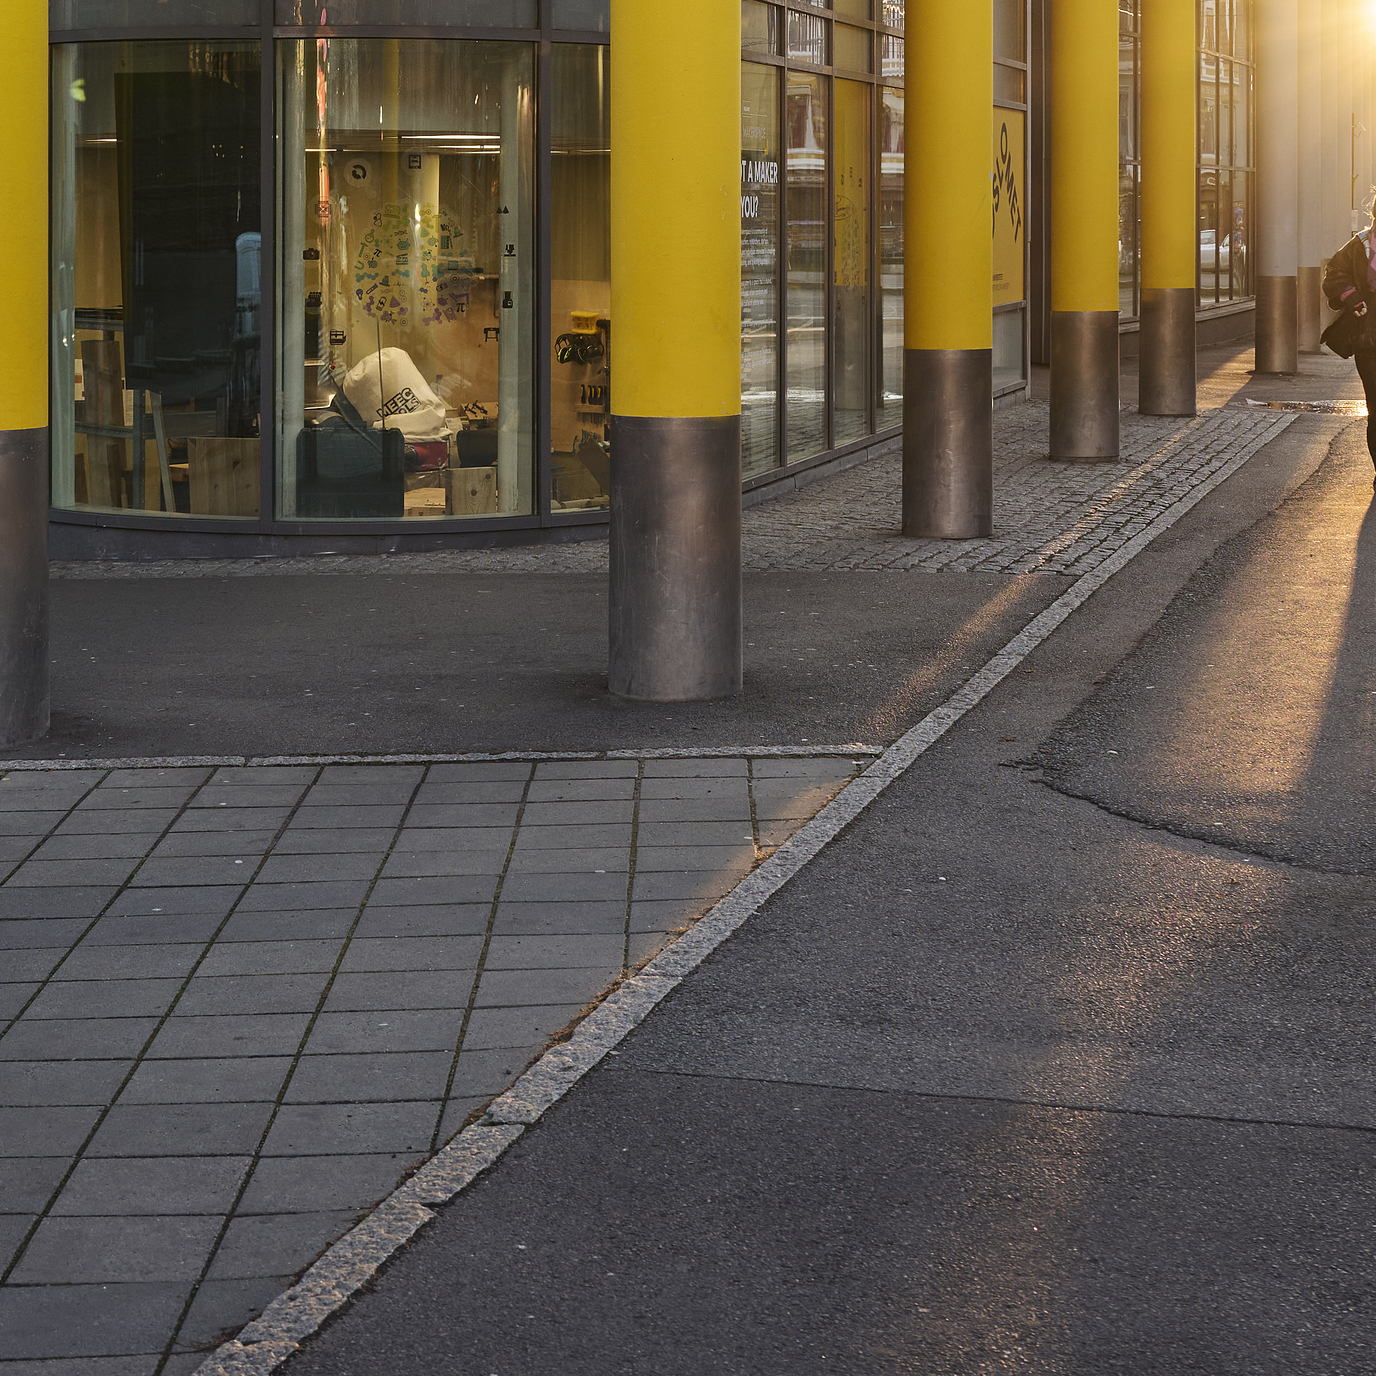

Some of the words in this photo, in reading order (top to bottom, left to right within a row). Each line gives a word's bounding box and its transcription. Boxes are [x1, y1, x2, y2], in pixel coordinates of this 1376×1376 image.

[747, 161, 753, 182] A
[754, 161, 778, 184] MAKER
[376, 387, 414, 417] MEEC
